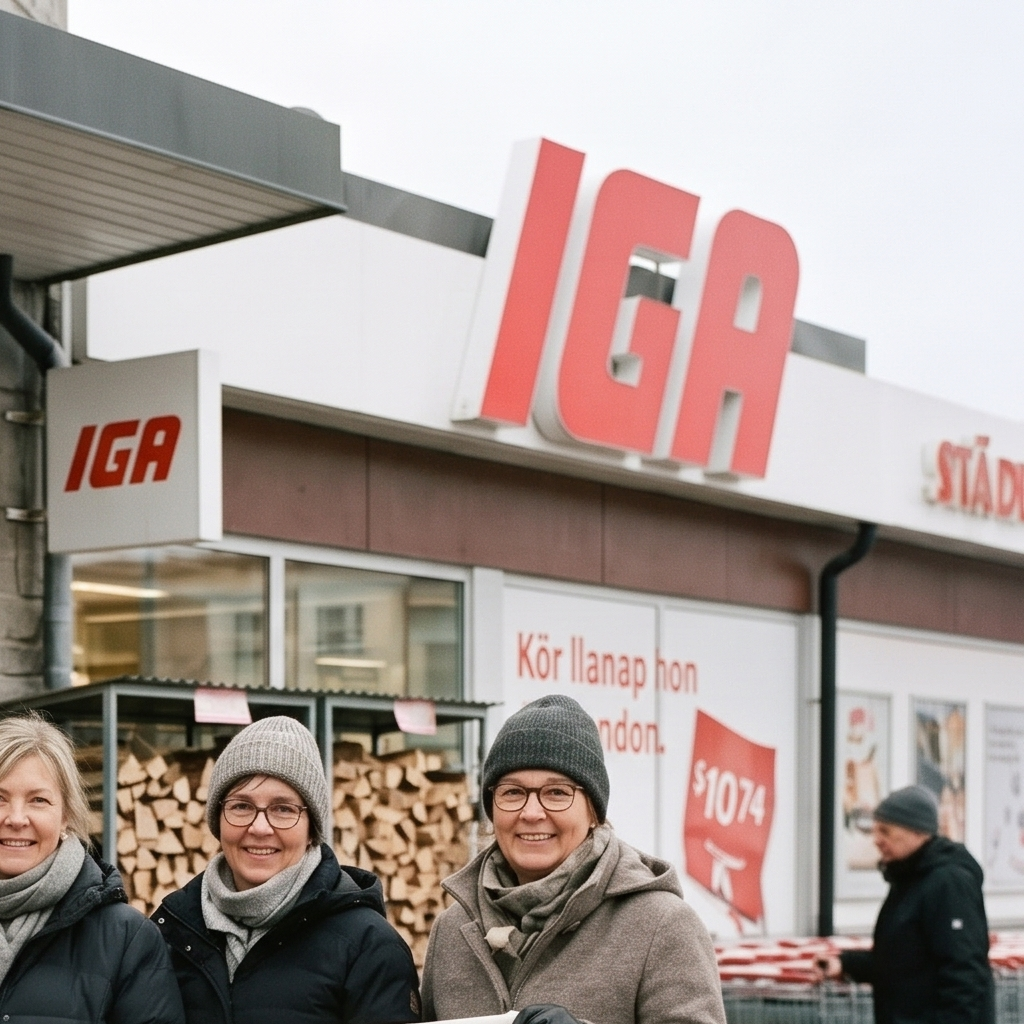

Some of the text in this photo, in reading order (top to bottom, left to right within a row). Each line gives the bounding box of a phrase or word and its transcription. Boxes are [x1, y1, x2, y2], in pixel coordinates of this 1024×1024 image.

[480, 138, 799, 478] IGA
[65, 415, 182, 492] IGA
[517, 631, 563, 681] Kör
